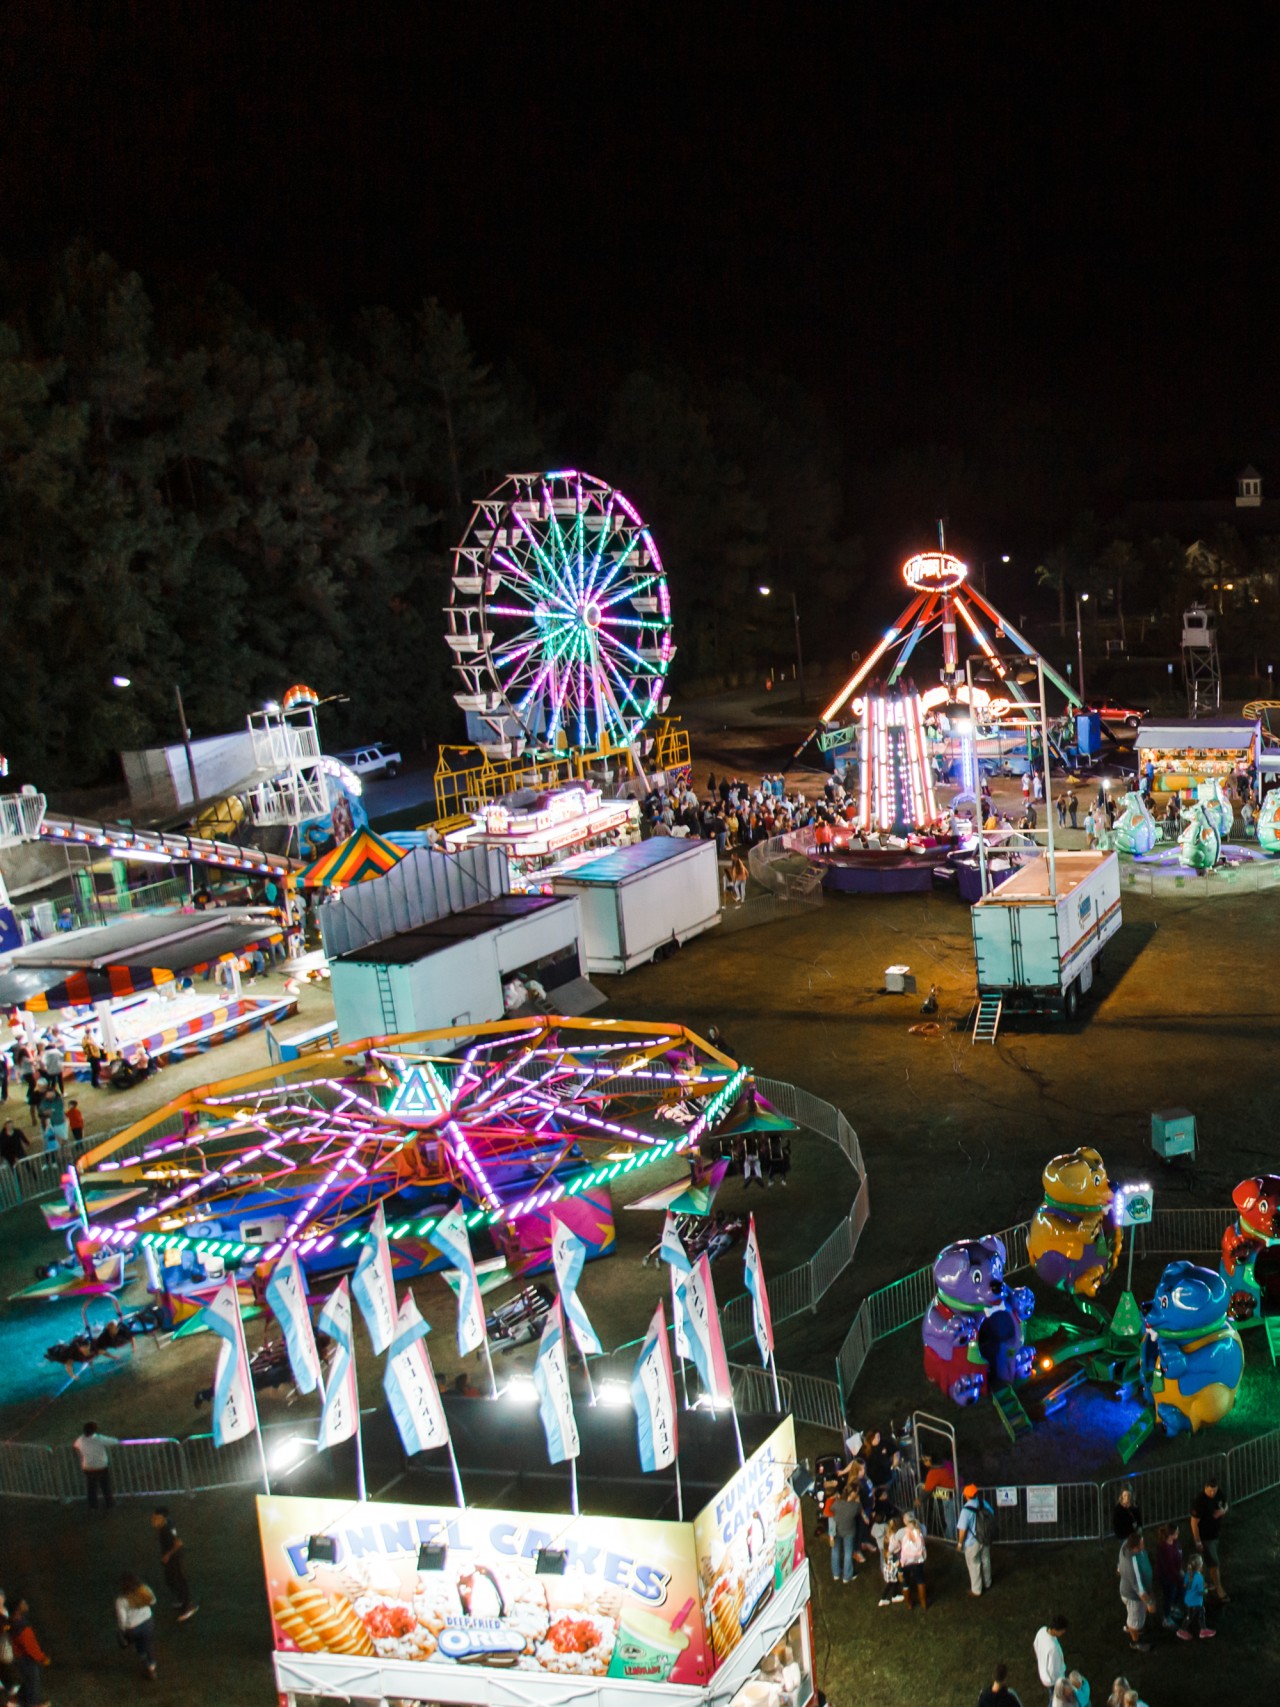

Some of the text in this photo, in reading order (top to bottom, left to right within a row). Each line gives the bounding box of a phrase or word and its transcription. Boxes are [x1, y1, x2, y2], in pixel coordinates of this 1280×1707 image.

[715, 1447, 776, 1526] FUNNEL
[723, 1471, 775, 1545] CAKES
[489, 1522, 667, 1600] CAKES
[441, 1629, 527, 1651] OREO
[446, 1616, 501, 1630] DEEP FRIED
